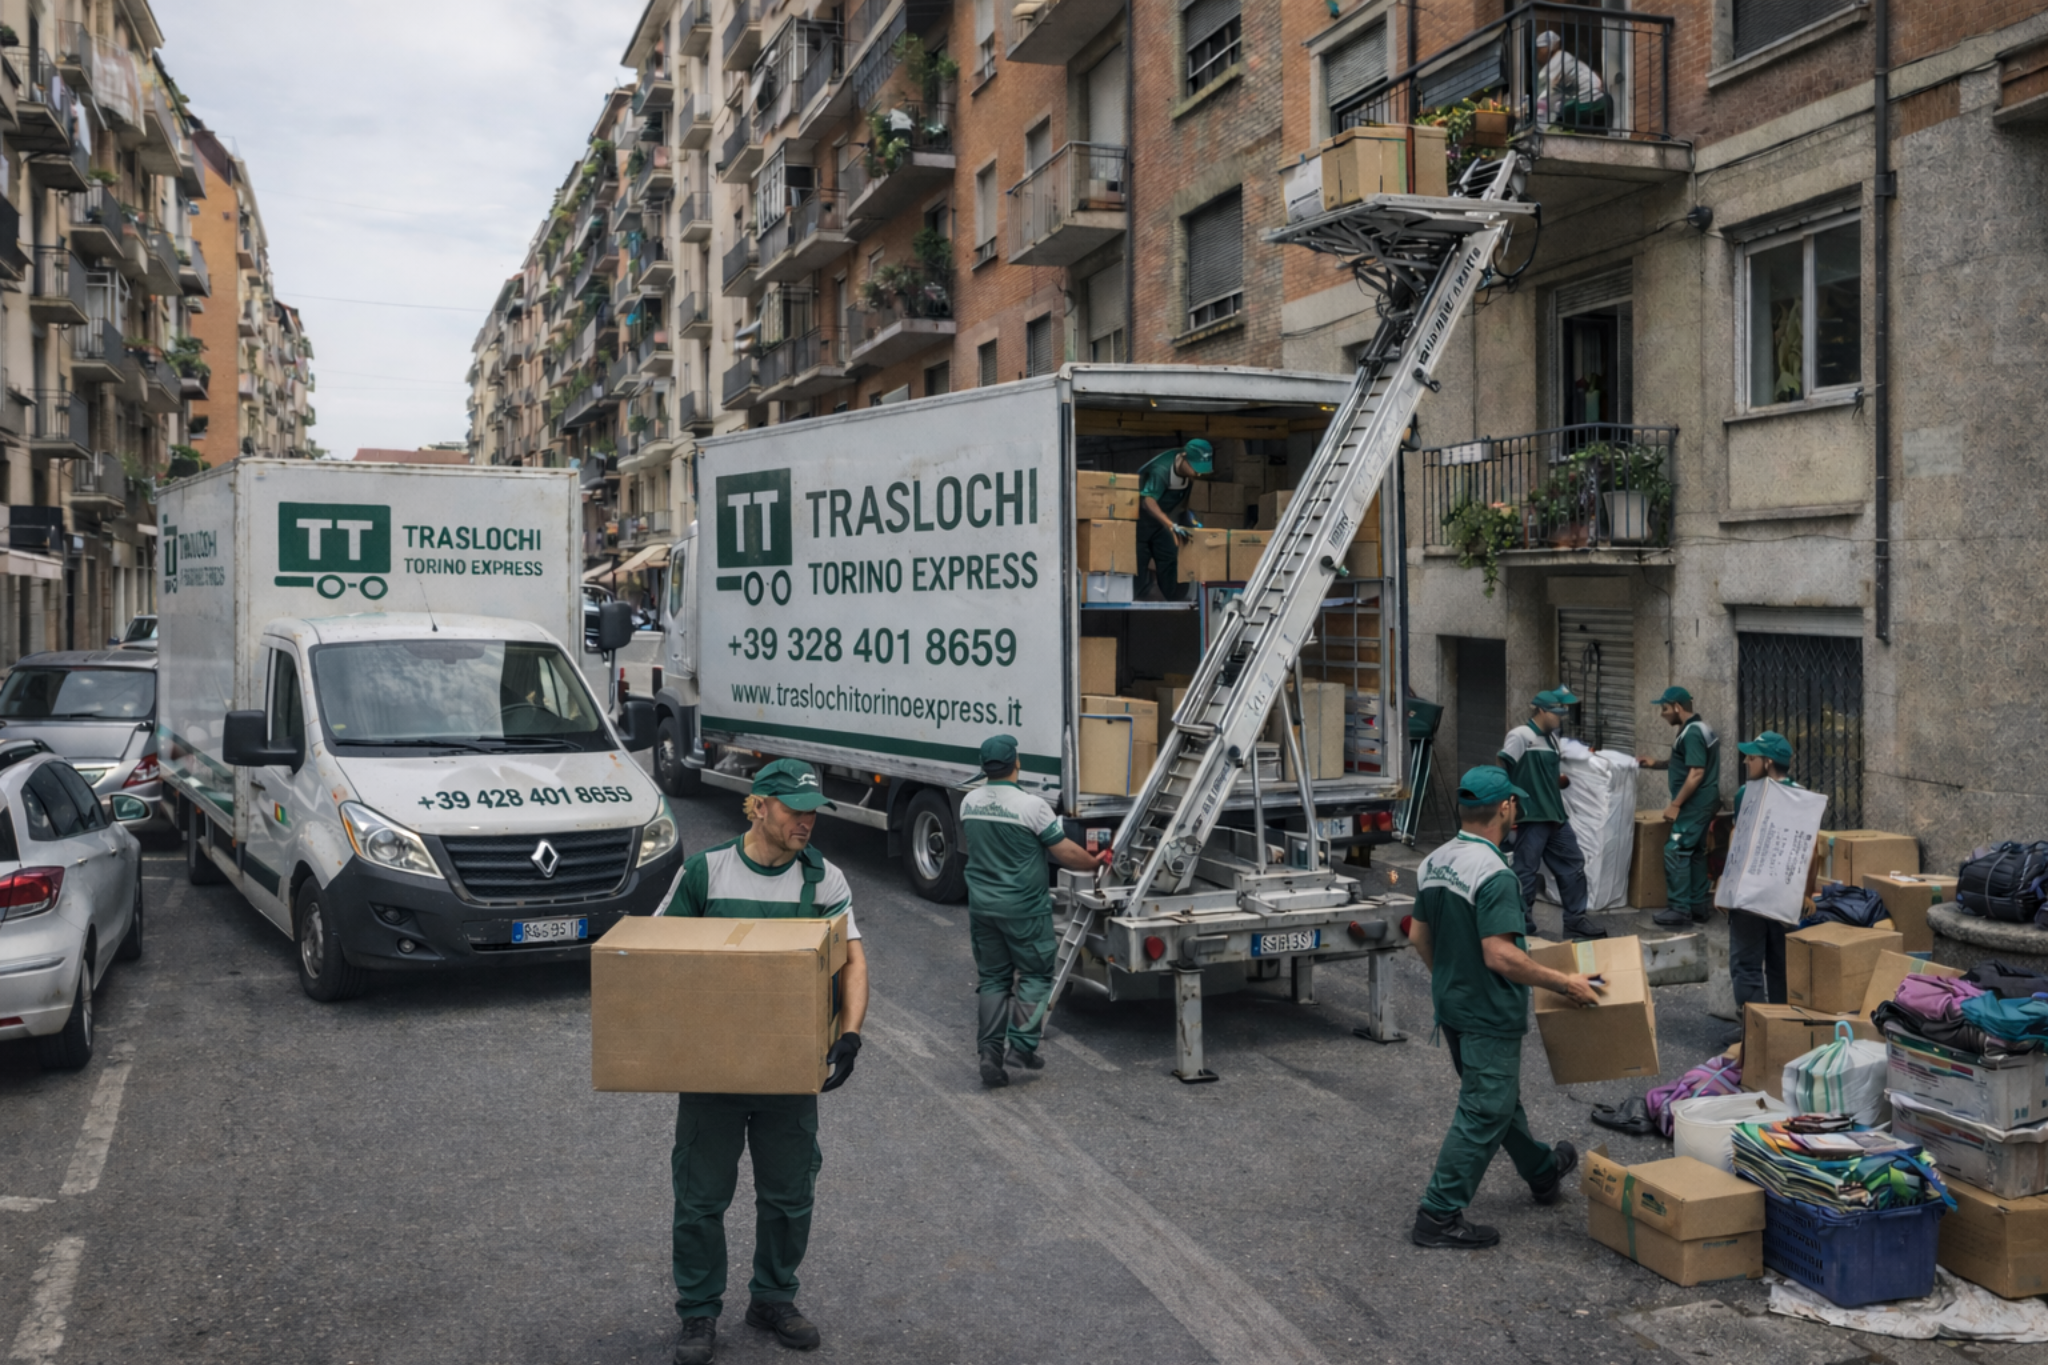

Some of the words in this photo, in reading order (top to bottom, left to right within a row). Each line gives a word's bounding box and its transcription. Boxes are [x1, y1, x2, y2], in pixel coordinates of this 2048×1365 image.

[727, 489, 779, 552] TT
[805, 467, 1038, 538] TRASLOCHI
[296, 518, 373, 561] TT
[402, 525, 541, 551] TRASLOCHI
[403, 558, 467, 576] TORINO
[471, 559, 543, 577] EXPRESS
[807, 559, 903, 595] TORINO
[912, 551, 1038, 592] EXPRESS
[728, 627, 778, 661] +39
[787, 627, 843, 663] 328
[853, 627, 910, 665] 401
[925, 627, 1017, 667] 8659
[731, 682, 1023, 729] www.traslochitorinoexpress.it
[418, 790, 471, 810] +39
[476, 788, 524, 809] 428
[529, 786, 572, 806] 401
[574, 786, 633, 804] 8659
